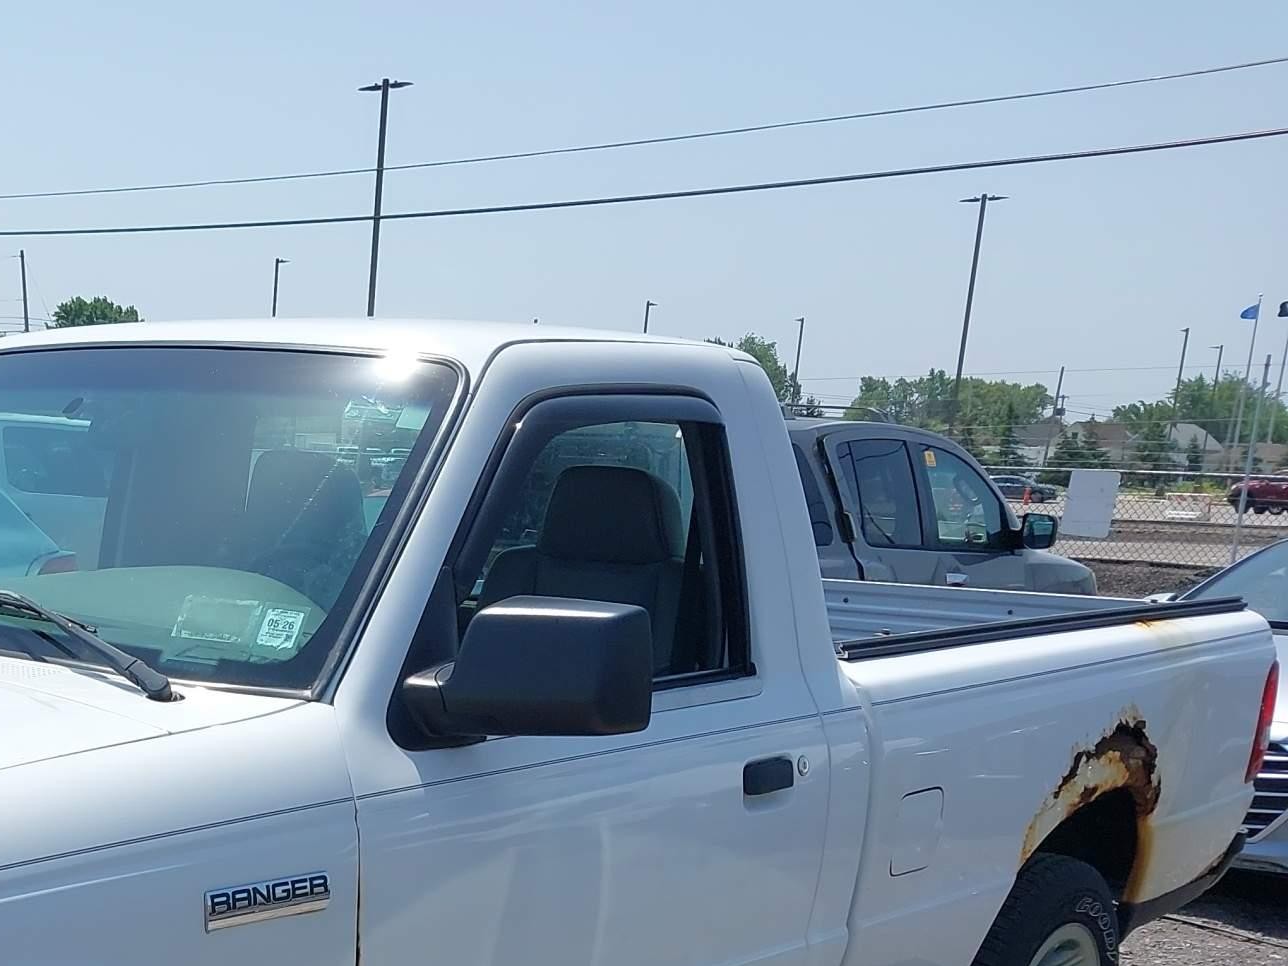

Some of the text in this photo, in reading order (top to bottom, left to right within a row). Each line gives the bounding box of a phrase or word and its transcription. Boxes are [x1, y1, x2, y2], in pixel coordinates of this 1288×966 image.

[267, 618, 295, 630] 05 26
[209, 874, 329, 916] RANGER
